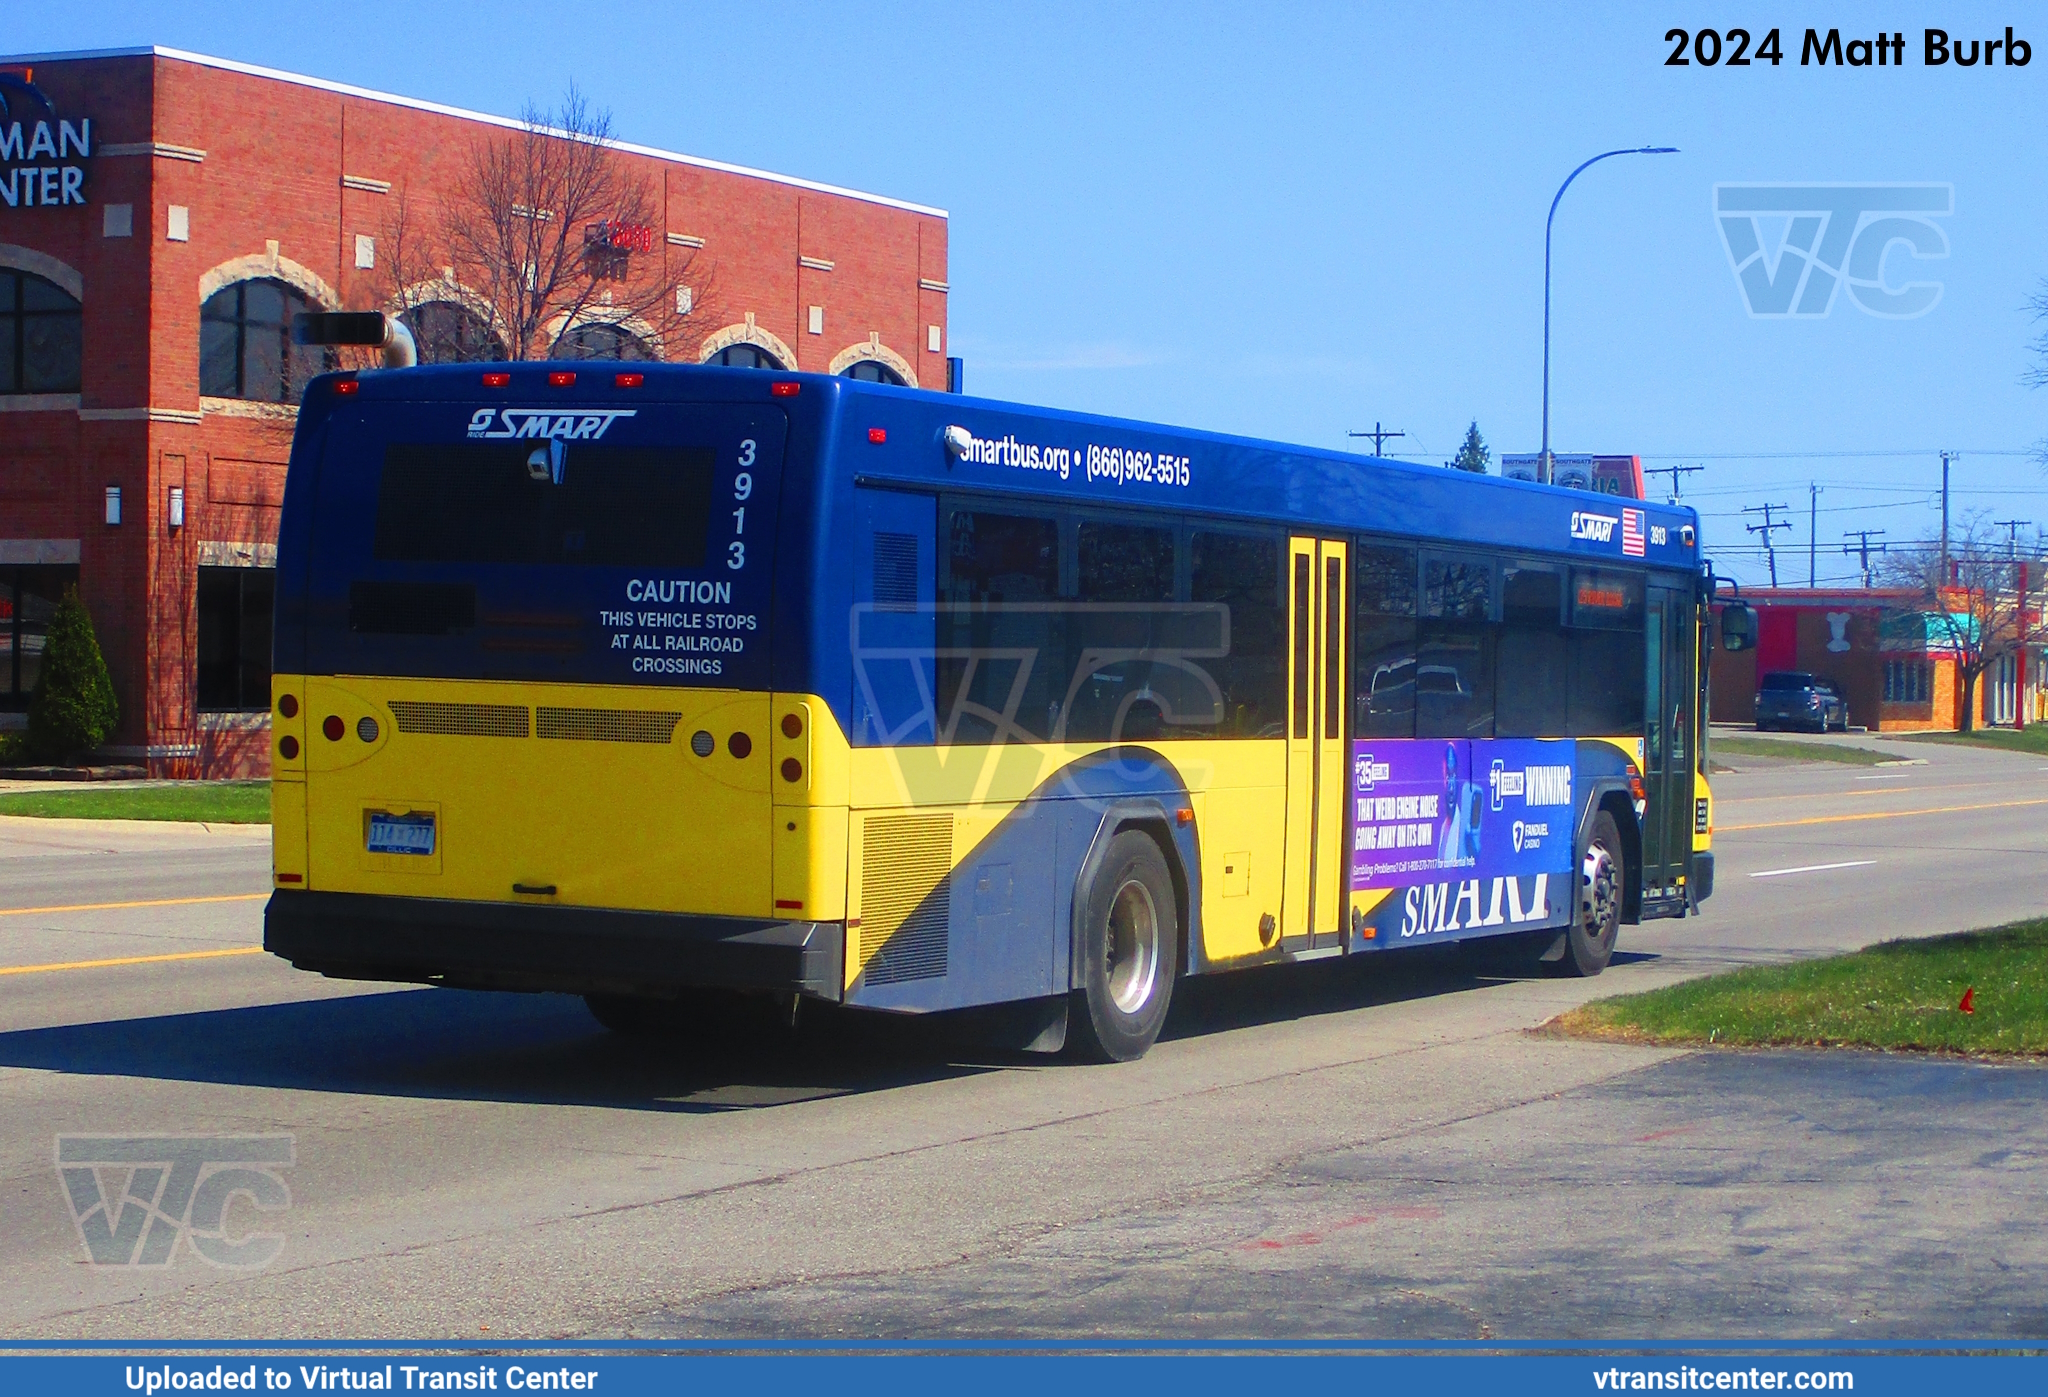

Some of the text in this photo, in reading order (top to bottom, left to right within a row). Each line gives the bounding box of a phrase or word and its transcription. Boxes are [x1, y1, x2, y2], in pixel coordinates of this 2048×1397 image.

[485, 408, 638, 439] SMART
[1086, 443, 1191, 487] (866)962-5515
[727, 439, 757, 570] 3913
[1576, 512, 1619, 542] SMART
[1650, 525, 1667, 546] 3913
[626, 579, 731, 604] CAUTION
[600, 611, 757, 631] THIS VEHICLE STOPS
[611, 634, 744, 653] AT ALL RAILROAD
[632, 656, 722, 675] CROSSINGS
[1355, 760, 1372, 785] #35
[1489, 765, 1571, 806] #1 FEELING WINNING
[1357, 795, 1438, 821] THAT WEIRD ENGINE NOISE
[1355, 823, 1432, 851] GOING AWAY ON ITS OWN
[1525, 823, 1548, 837] FANDUEL
[1524, 838, 1540, 849] CASINO
[1353, 864, 1374, 877] Gambling
[1374, 862, 1399, 875] Problems?
[1399, 861, 1407, 872] Call
